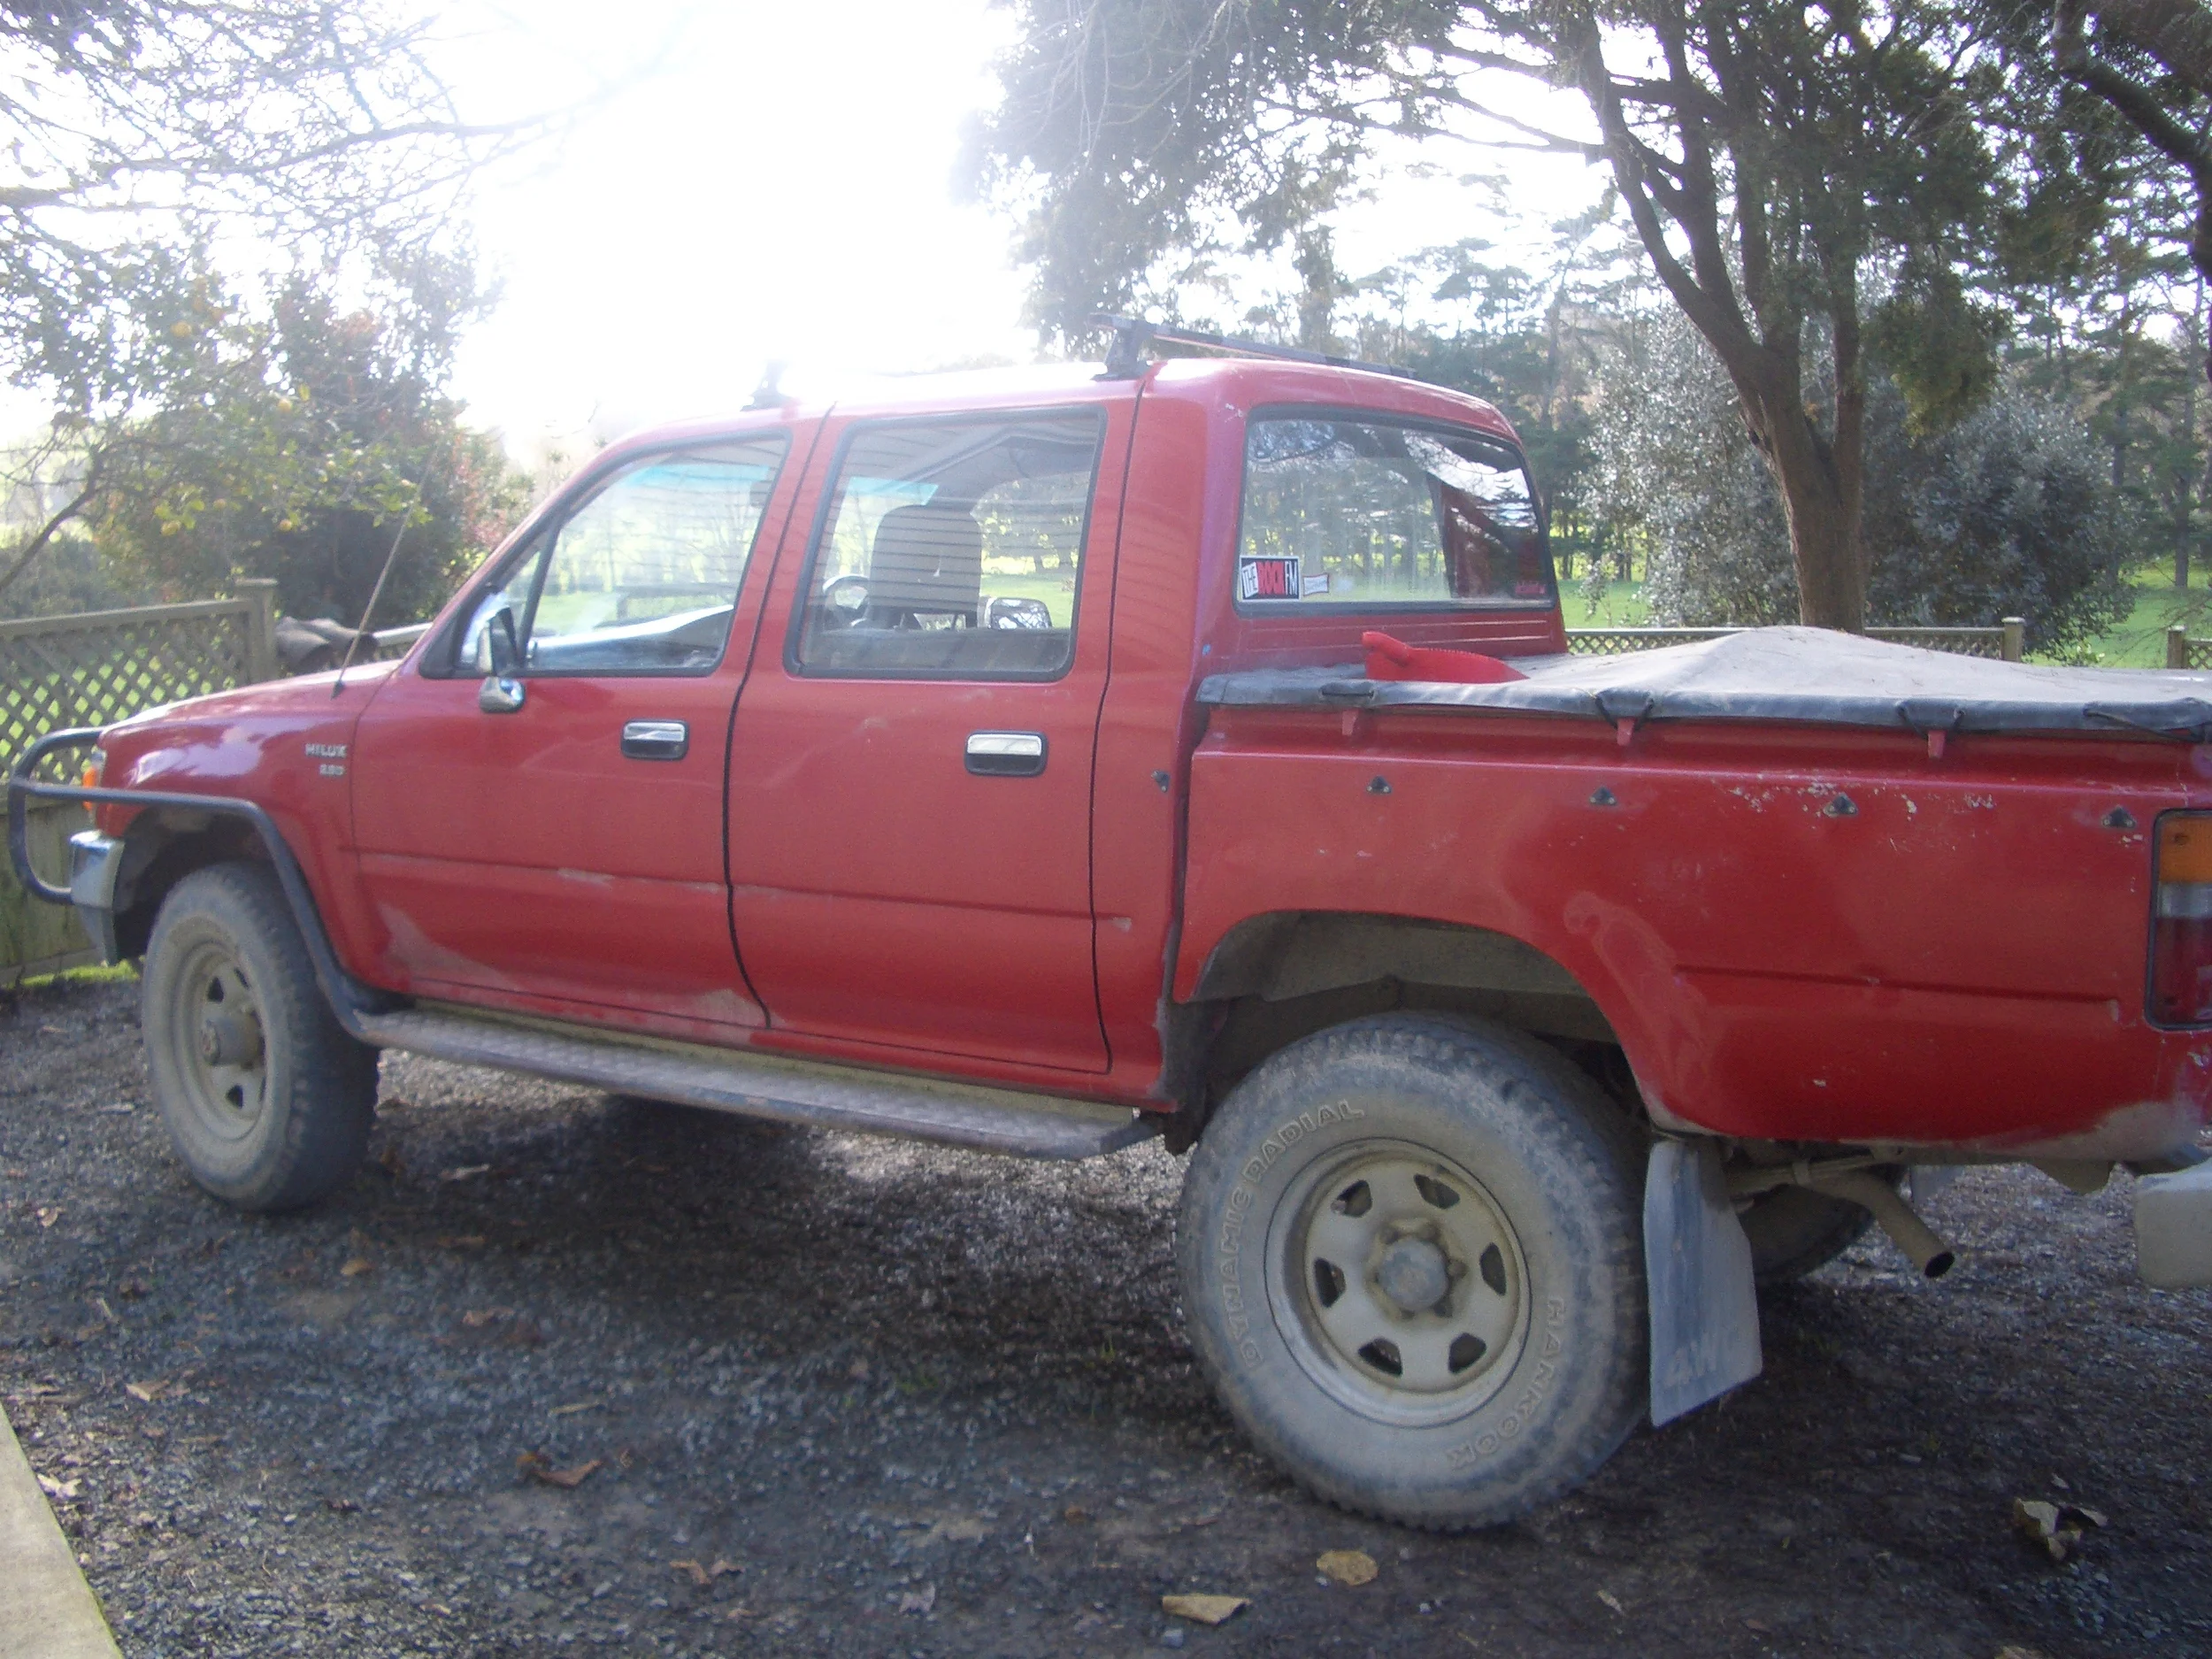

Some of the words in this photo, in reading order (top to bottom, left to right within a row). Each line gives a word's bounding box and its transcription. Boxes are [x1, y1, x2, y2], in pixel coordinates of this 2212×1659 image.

[1241, 561, 1259, 598] THE
[305, 743, 347, 758] HILUX
[1241, 1099, 1364, 1184] RADIAL
[1446, 1298, 1567, 1470] HANKOOK
